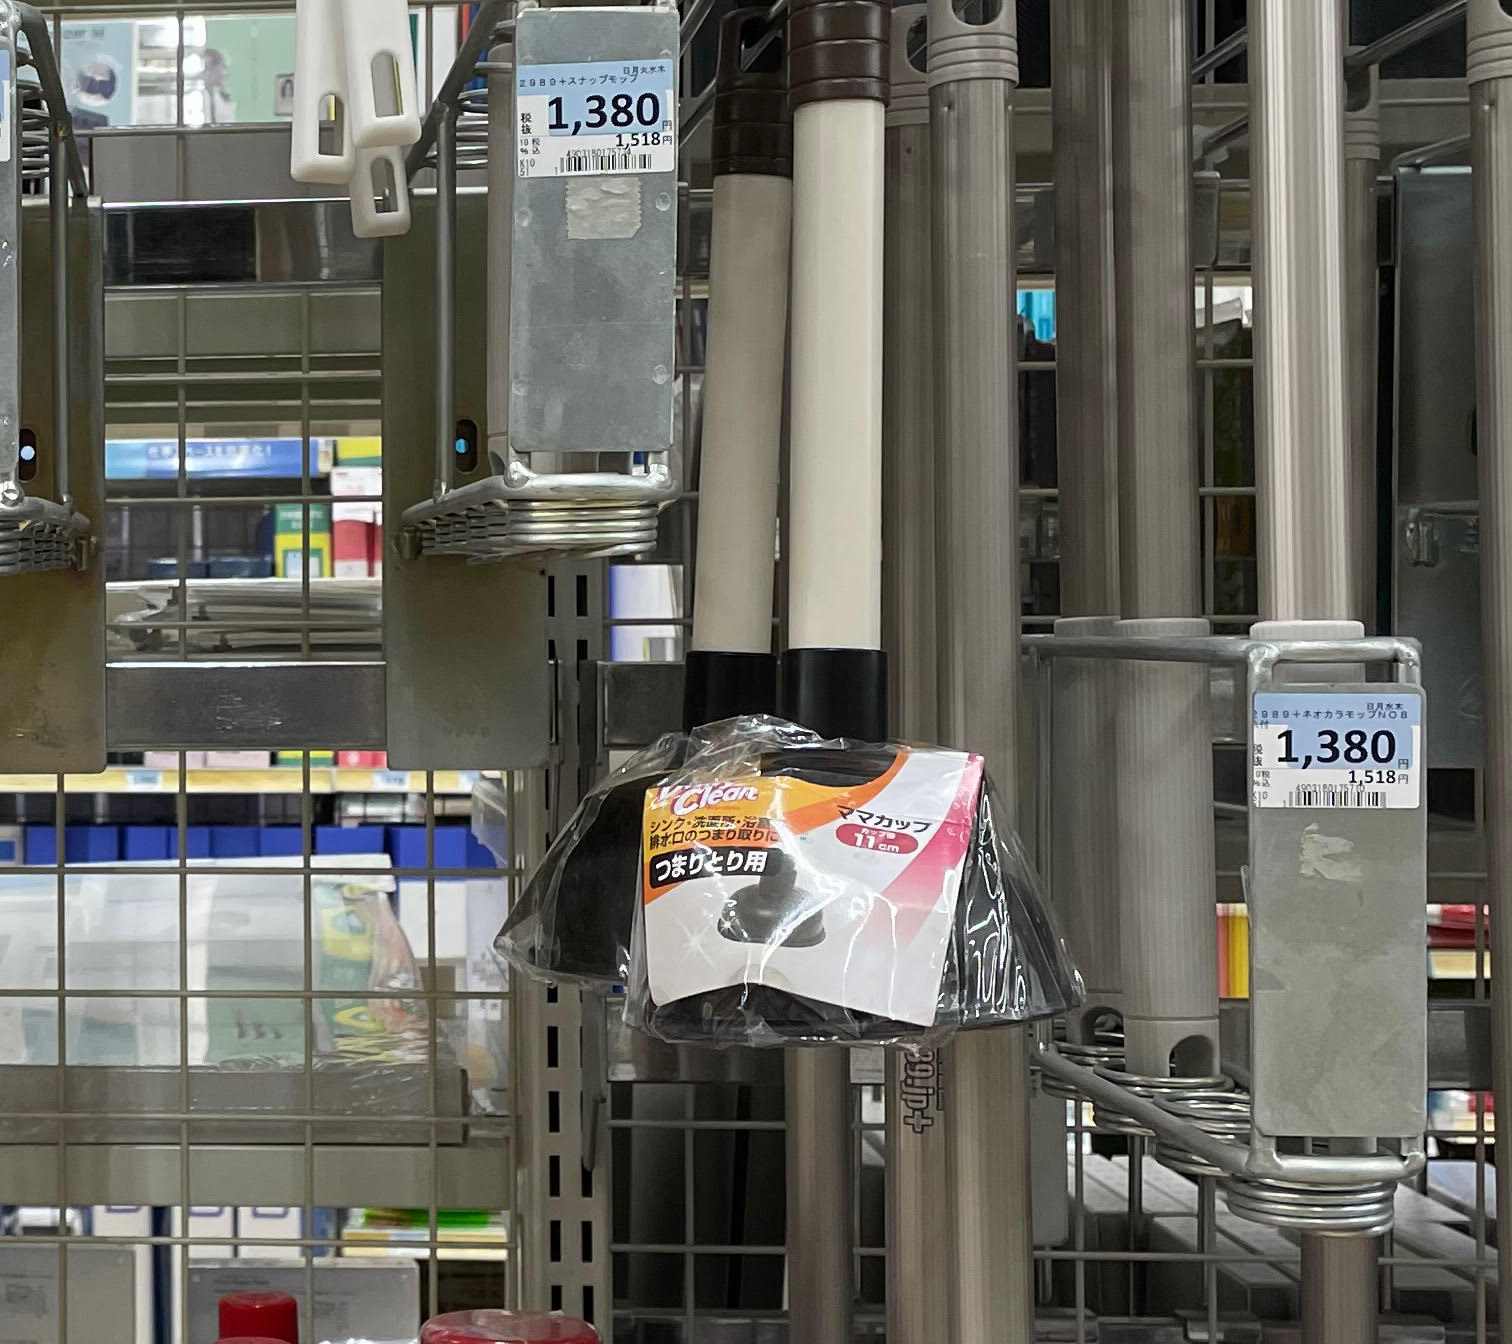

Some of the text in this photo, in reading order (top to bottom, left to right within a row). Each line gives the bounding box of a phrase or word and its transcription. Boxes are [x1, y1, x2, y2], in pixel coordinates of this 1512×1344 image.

[835, 804, 934, 834] ママカップ
[655, 850, 767, 883] つまりとり用
